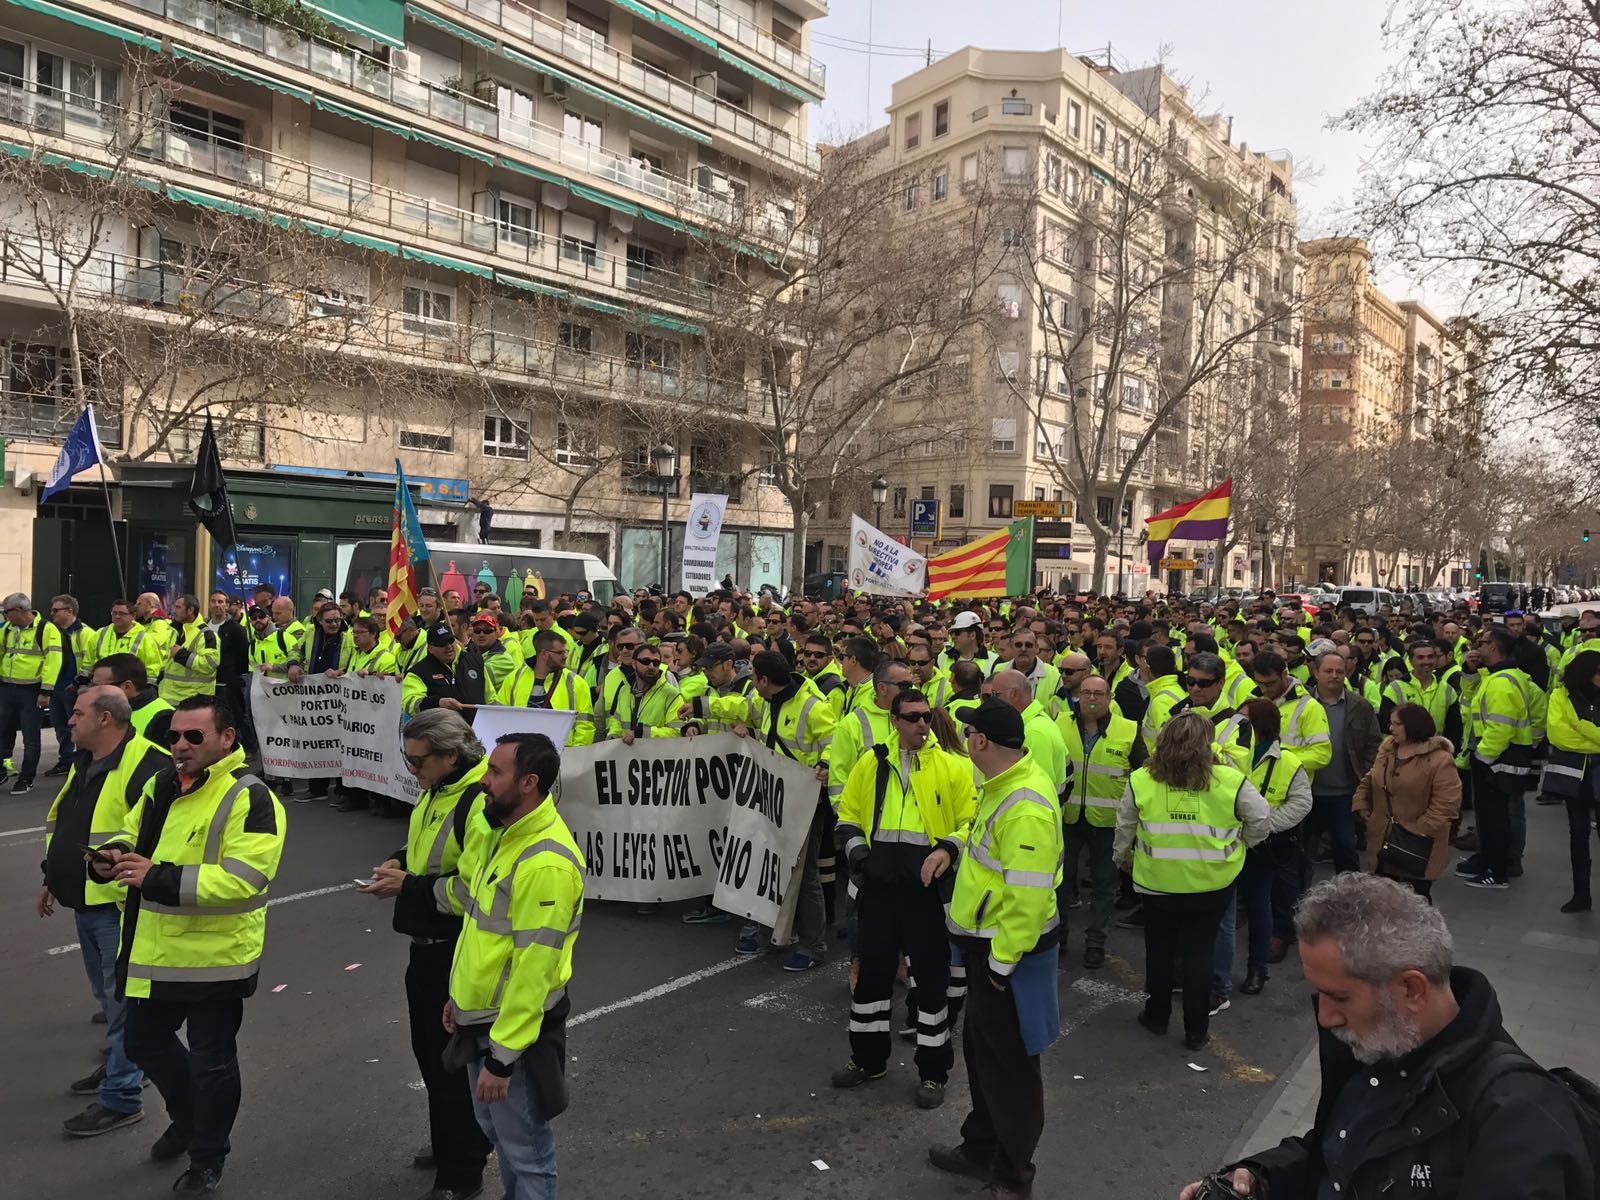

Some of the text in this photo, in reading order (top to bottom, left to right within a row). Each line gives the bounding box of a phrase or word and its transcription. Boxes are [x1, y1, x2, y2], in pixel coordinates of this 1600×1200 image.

[354, 514, 389, 524] prensa
[873, 539, 899, 557] NO A LA
[868, 545, 899, 566] DIRECTIVA
[683, 558, 714, 568] COORDINADORA
[685, 572, 711, 581] ESTIBADORES
[689, 585, 709, 593] VALENCIA
[351, 690, 367, 701] DE
[289, 715, 308, 726] PARA
[310, 715, 334, 726] LOS
[266, 736, 290, 748] POR
[346, 747, 383, 763] FUERTE!
[263, 757, 313, 769] COORDINADORA
[594, 759, 623, 805] EL
[628, 758, 691, 807] SECTOR
[1170, 813, 1196, 821] SEVASA
[613, 832, 656, 881] LEYES
[663, 833, 702, 881] DEL
[756, 848, 783, 906] DEL
[1410, 1164, 1431, 1180] A&F
